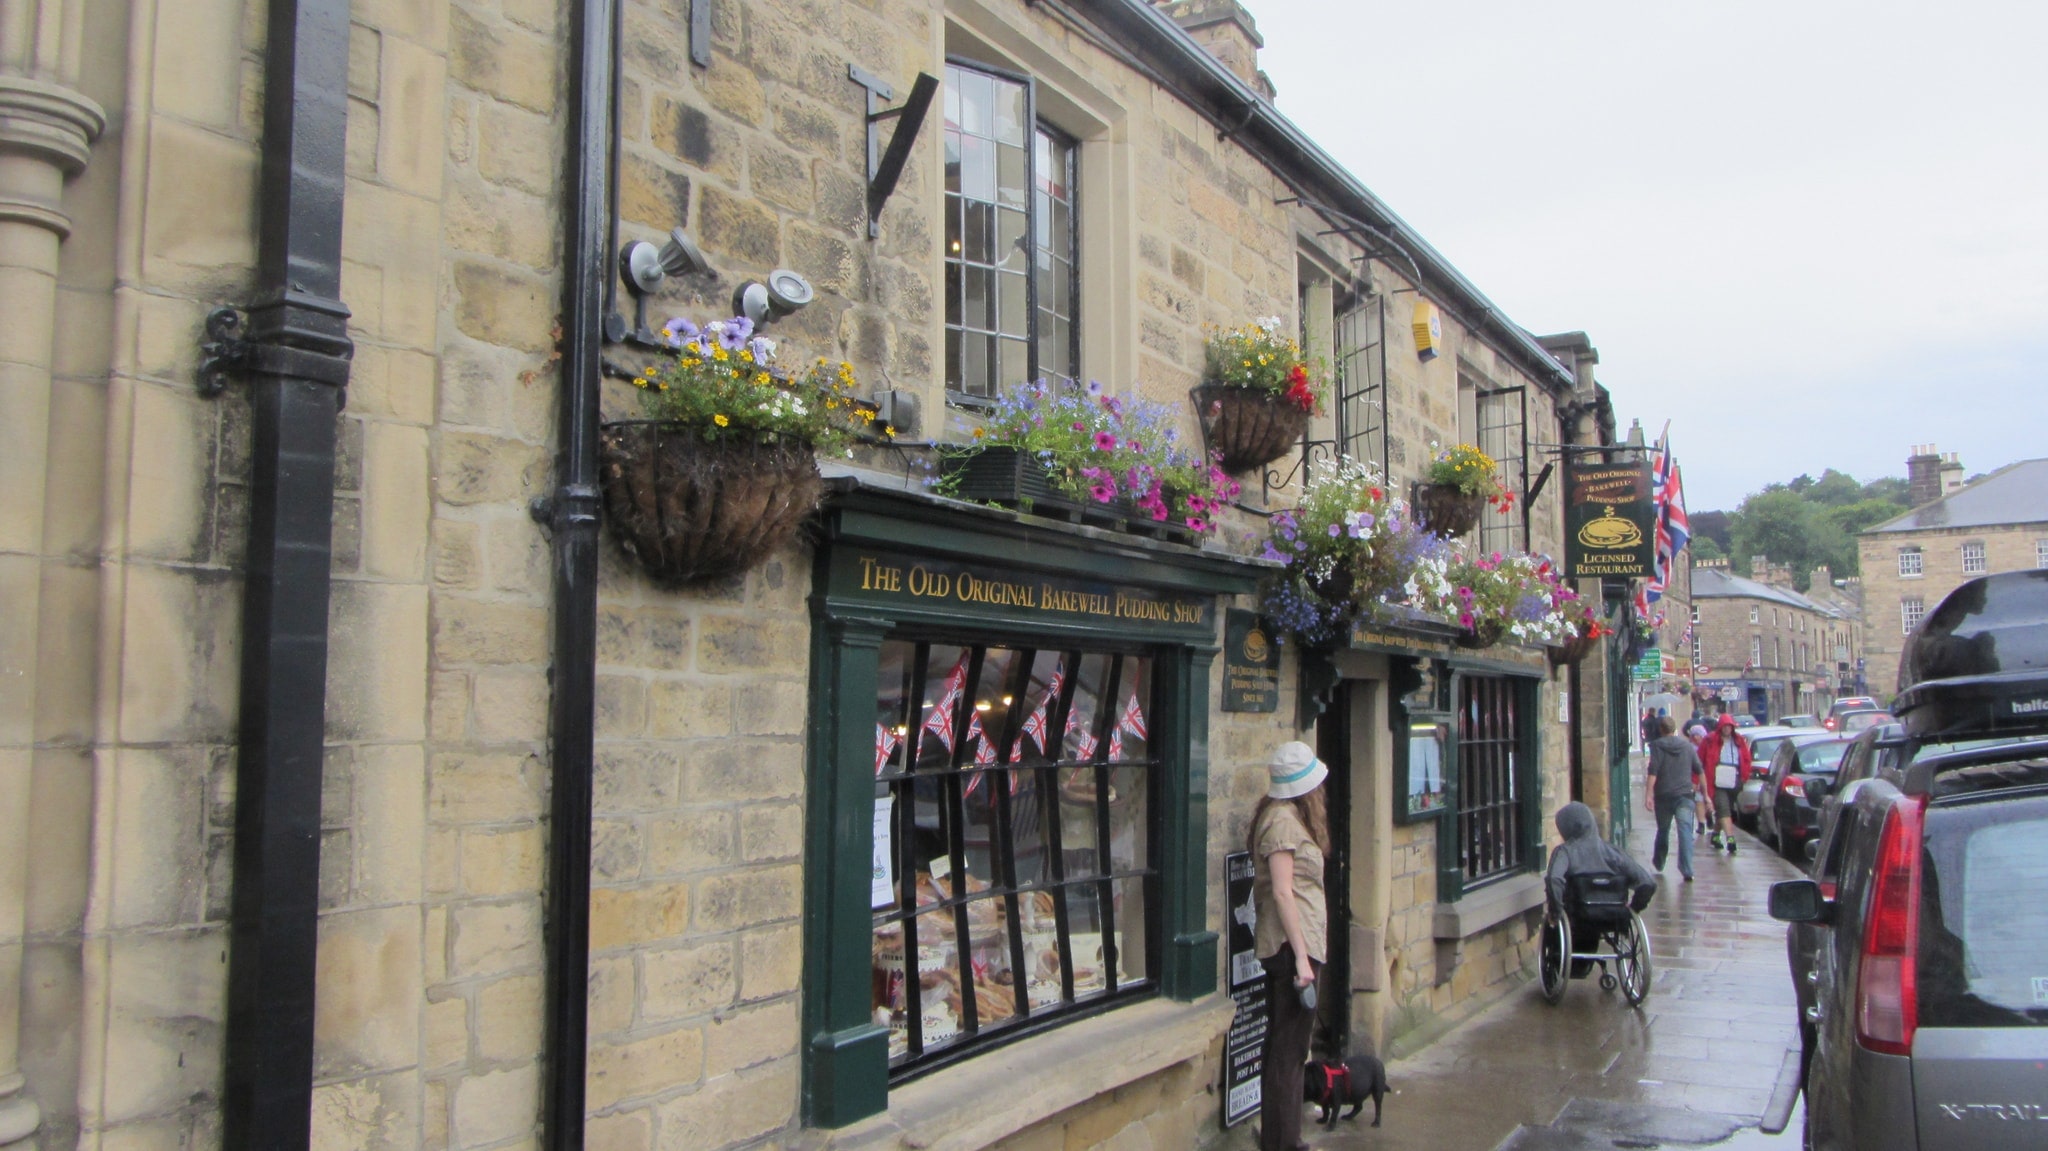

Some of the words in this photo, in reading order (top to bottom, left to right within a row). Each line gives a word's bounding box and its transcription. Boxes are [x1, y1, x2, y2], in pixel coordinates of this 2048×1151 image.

[1593, 471, 1608, 480] OLD
[1609, 470, 1641, 478] ORIGINAL
[1586, 494, 1617, 504] PUDDING
[1617, 495, 1636, 504] SHOP
[1583, 553, 1636, 563] LICENSED
[1576, 564, 1644, 574] RESTAURANT
[860, 556, 901, 592] THE
[908, 565, 950, 598] OLD
[956, 572, 1036, 608] ORIGINAL
[1040, 584, 1111, 616] BAKEWELL
[1114, 594, 1171, 622] PUDDING
[1174, 600, 1204, 624] SHOP
[1939, 1103, 2048, 1120] X-TRAIL
